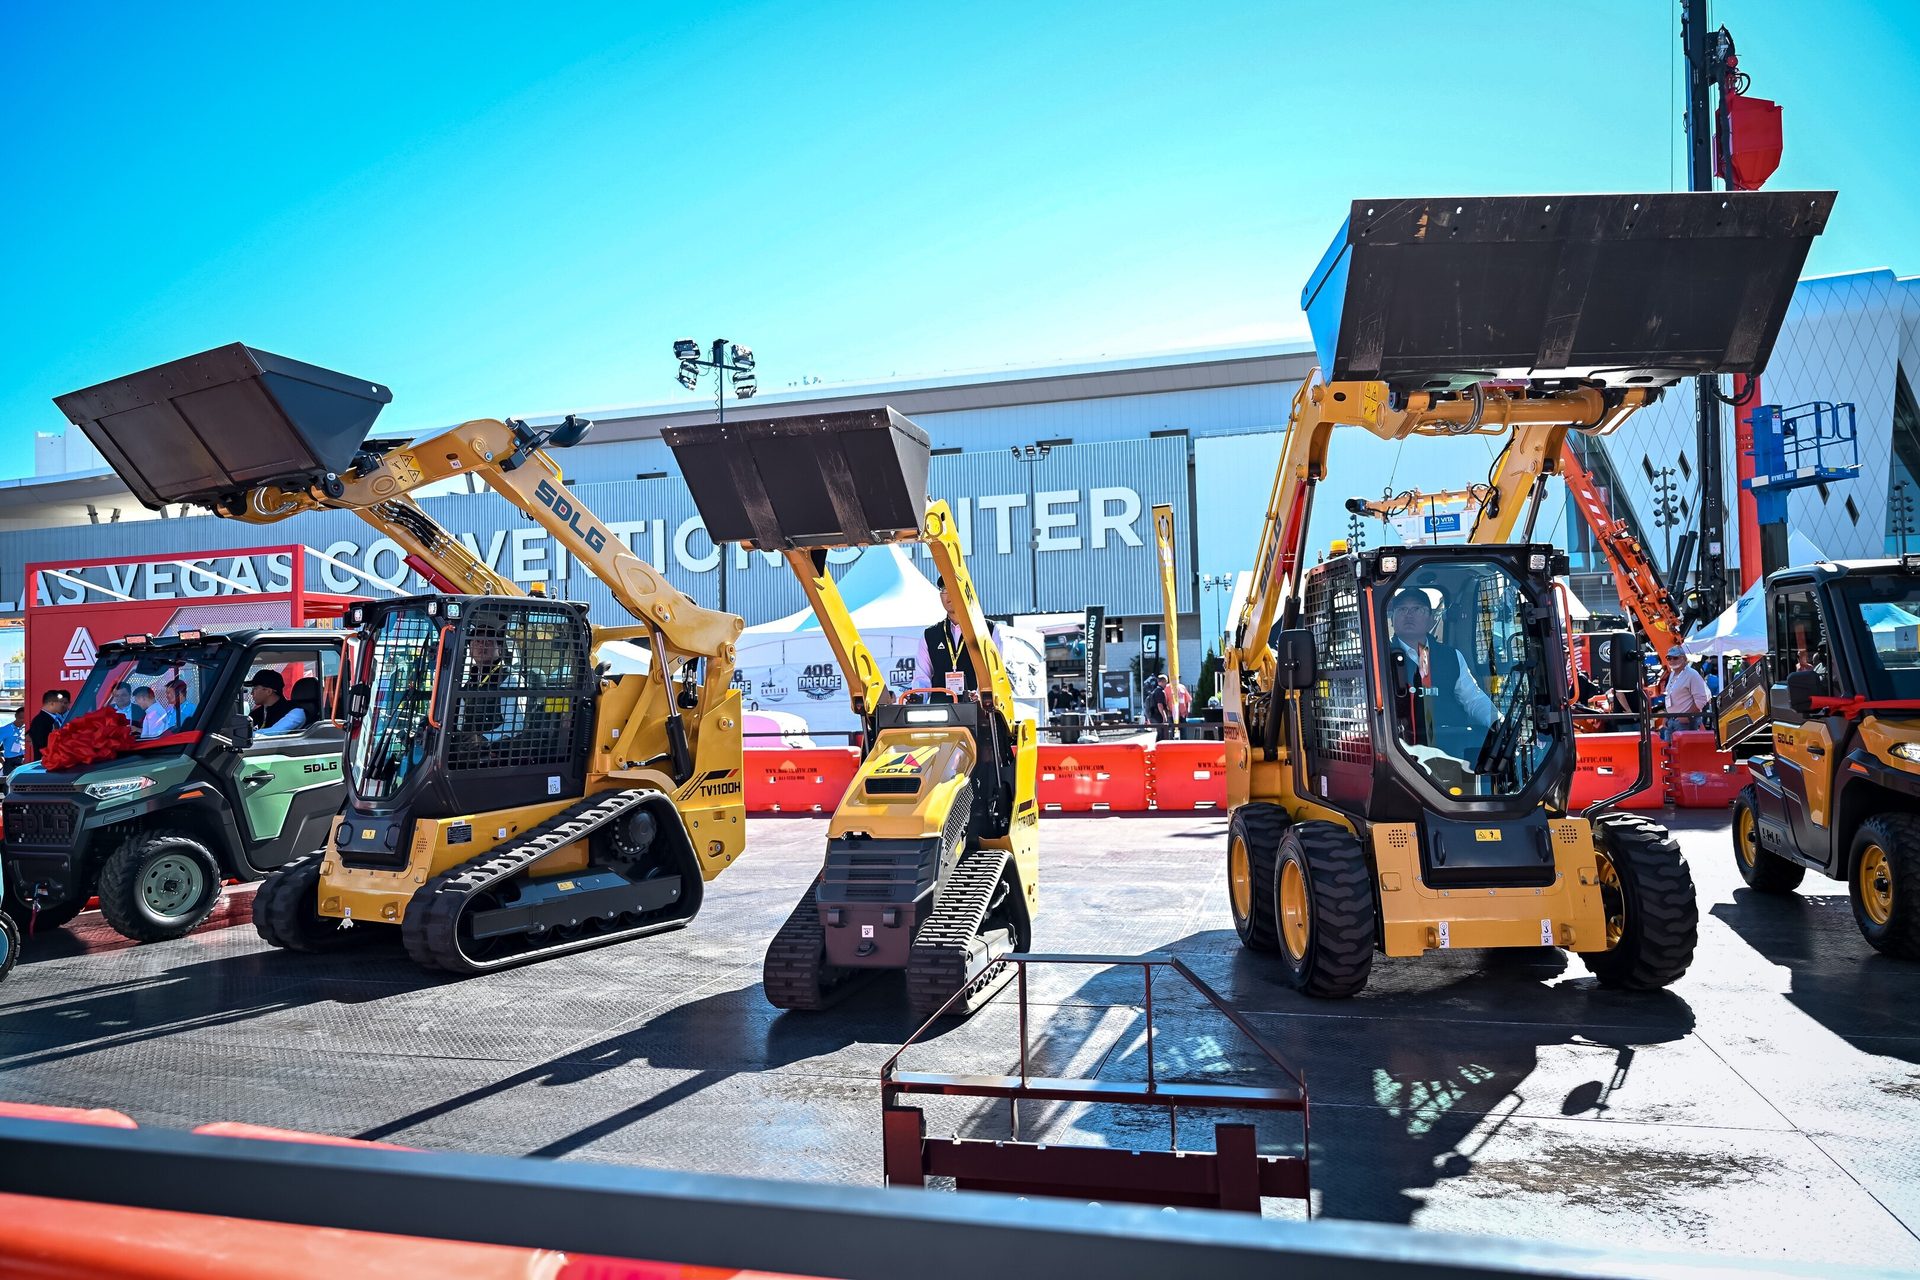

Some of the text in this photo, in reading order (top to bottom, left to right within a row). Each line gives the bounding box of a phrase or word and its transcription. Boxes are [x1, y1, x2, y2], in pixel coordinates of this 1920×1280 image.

[533, 479, 607, 553] SDLG
[105, 553, 292, 602] VEGAS
[1087, 615, 1097, 649] GRAVIS
[1143, 634, 1157, 652] G
[60, 669, 93, 681] LGM
[803, 663, 833, 677] 406
[798, 675, 841, 689] DREDGE
[1777, 733, 1794, 746] SDLG
[303, 761, 337, 774] SDLG
[874, 766, 922, 774] SDLG
[700, 782, 741, 798] TV1100H
